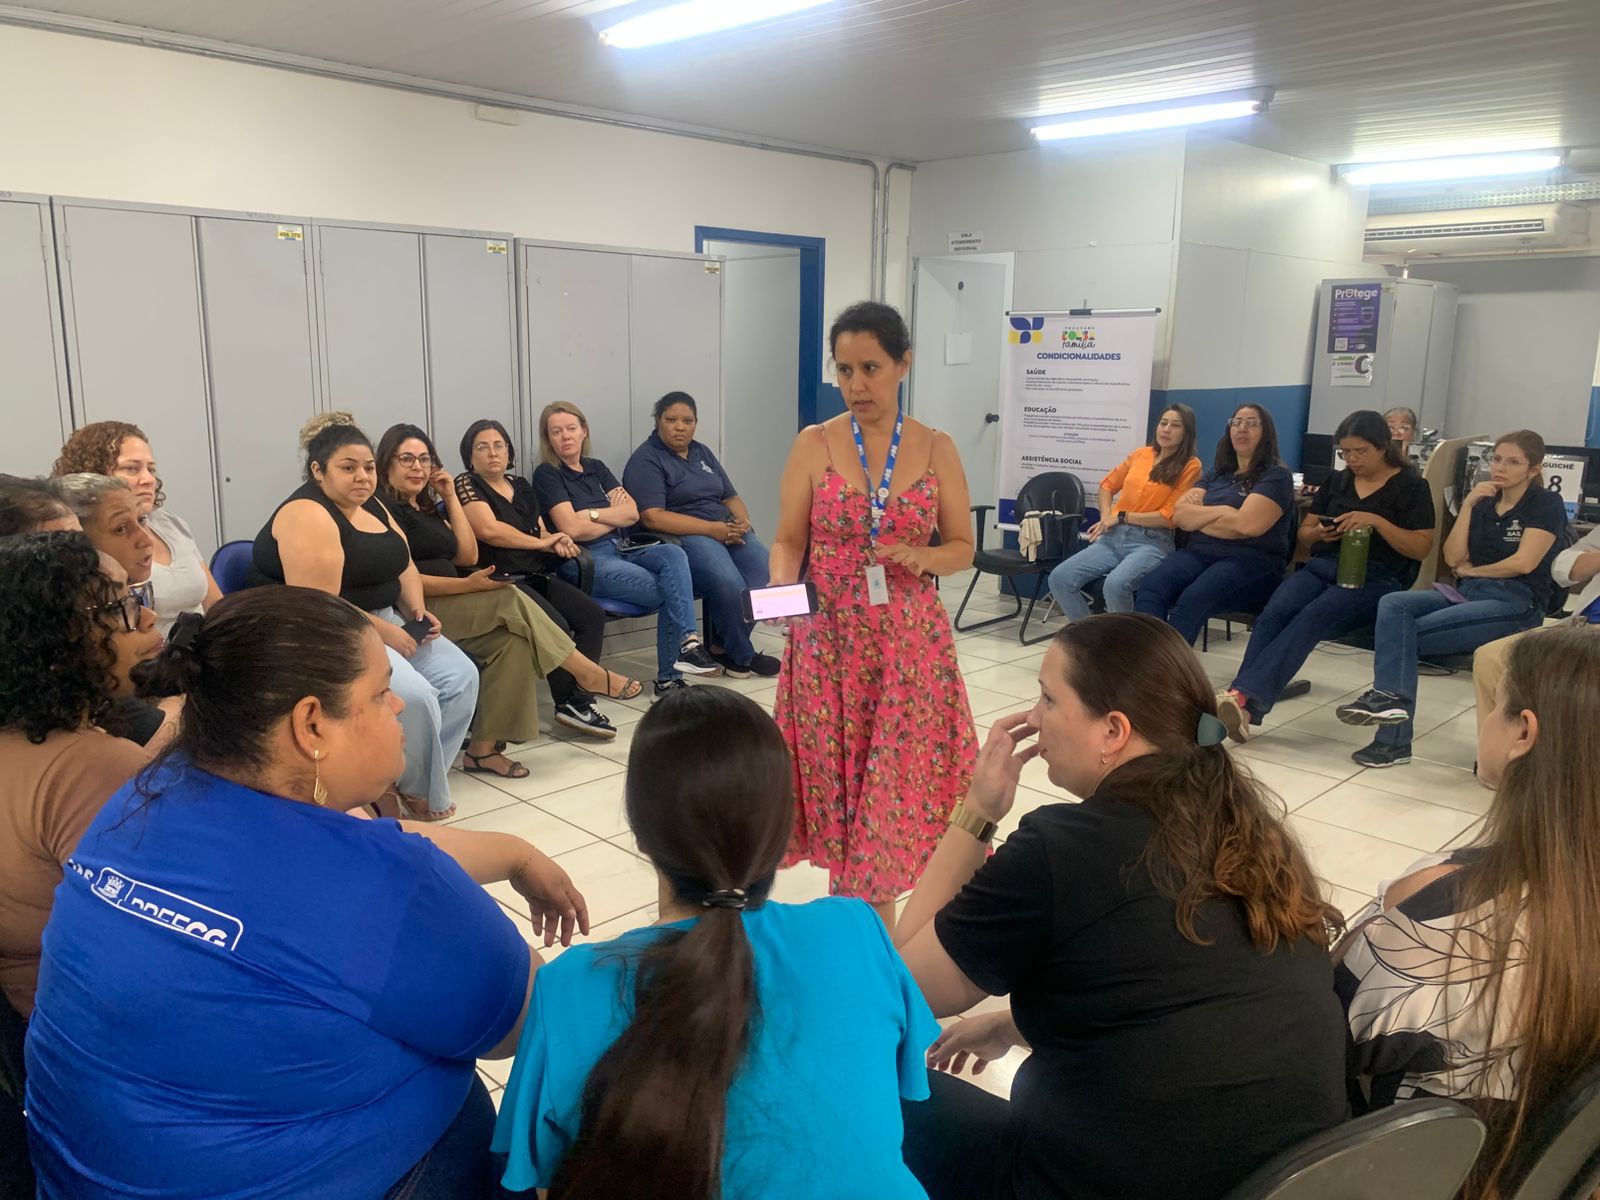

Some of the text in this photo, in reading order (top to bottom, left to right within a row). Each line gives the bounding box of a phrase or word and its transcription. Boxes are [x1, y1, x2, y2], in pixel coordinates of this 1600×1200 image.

[1036, 352, 1122, 361] CONDICIONALIDADES
[1023, 405, 1057, 415] EDUCAÇÃO
[1021, 454, 1082, 465] ASSISTÊNCIA SOCIAL
[1548, 475, 1562, 493] 8
